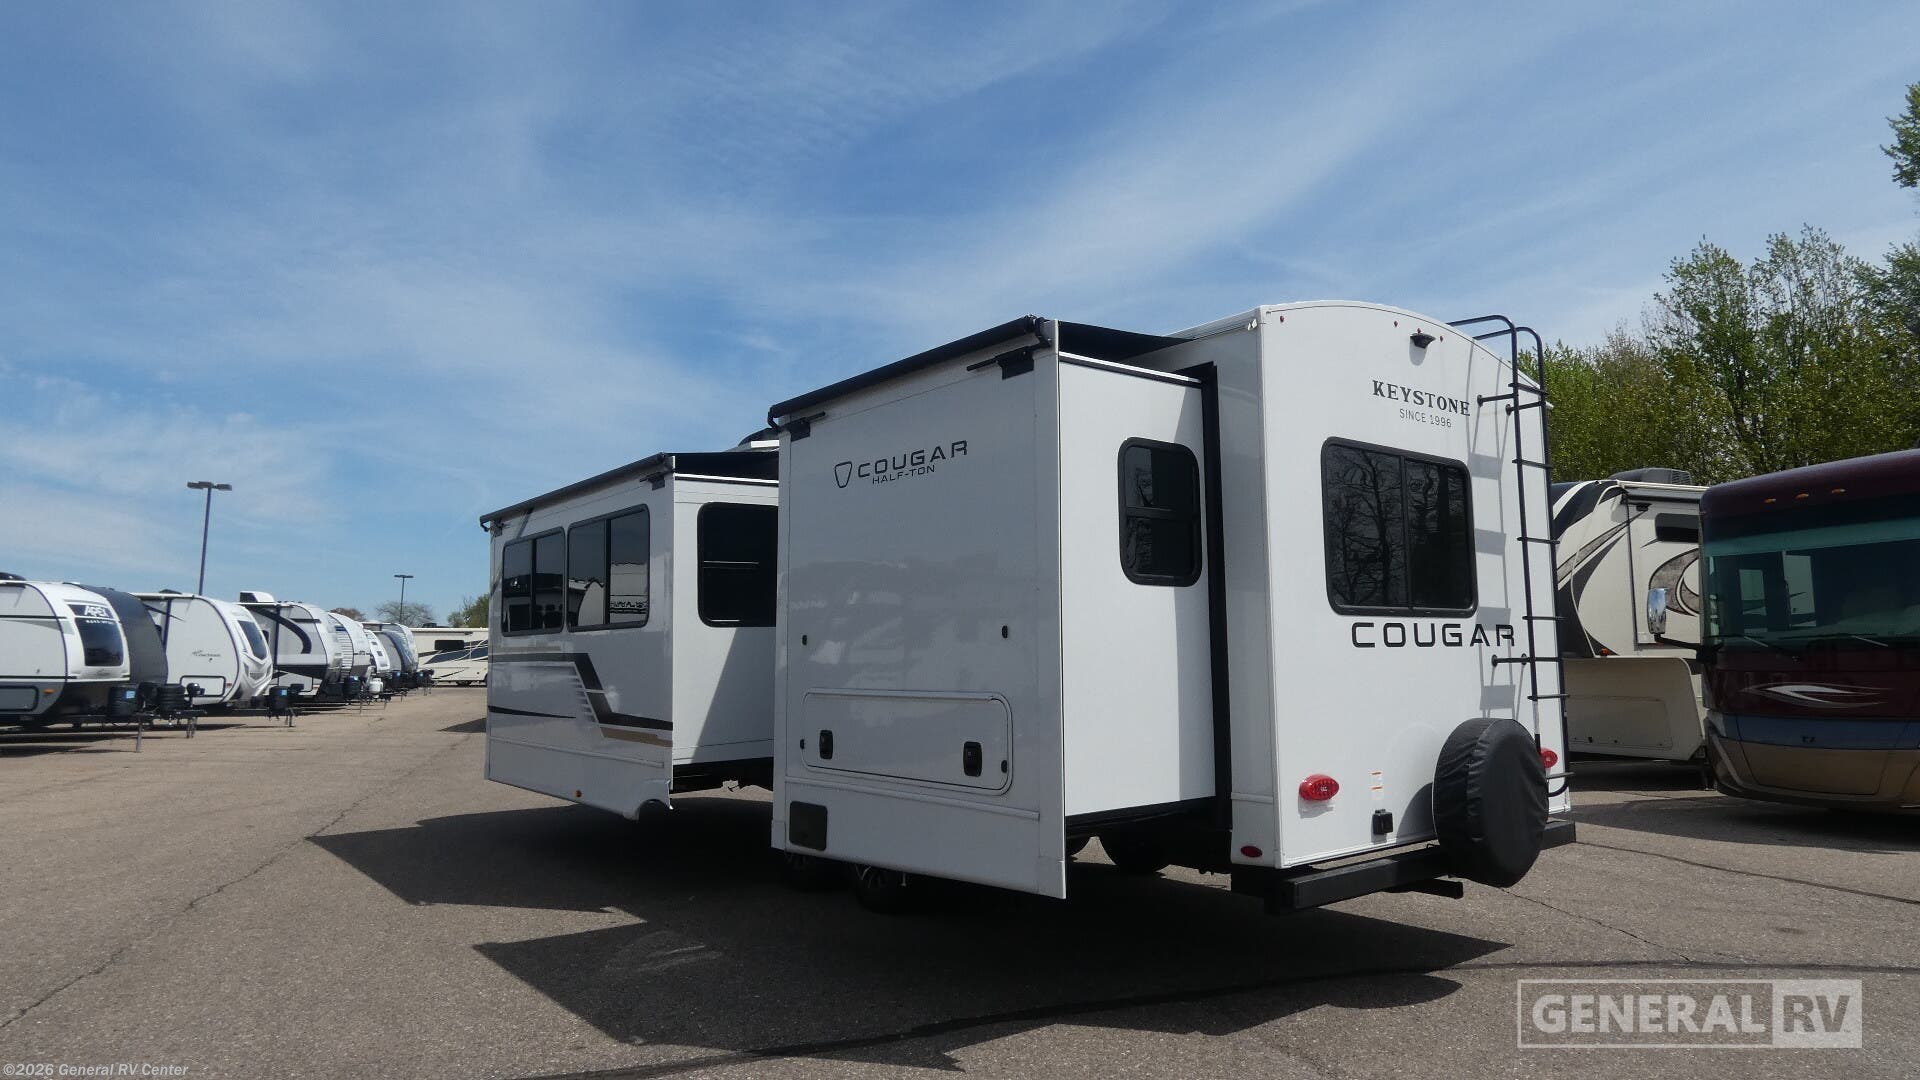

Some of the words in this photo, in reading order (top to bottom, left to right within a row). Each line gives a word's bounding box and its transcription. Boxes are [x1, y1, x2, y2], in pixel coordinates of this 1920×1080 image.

[1372, 379, 1471, 417] KEYSTONE
[1399, 408, 1427, 423] SINCE
[1430, 414, 1452, 428] 1996
[858, 440, 967, 478] COUGAR
[872, 464, 935, 485] HALF-TON
[1351, 622, 1515, 648] COUGAR
